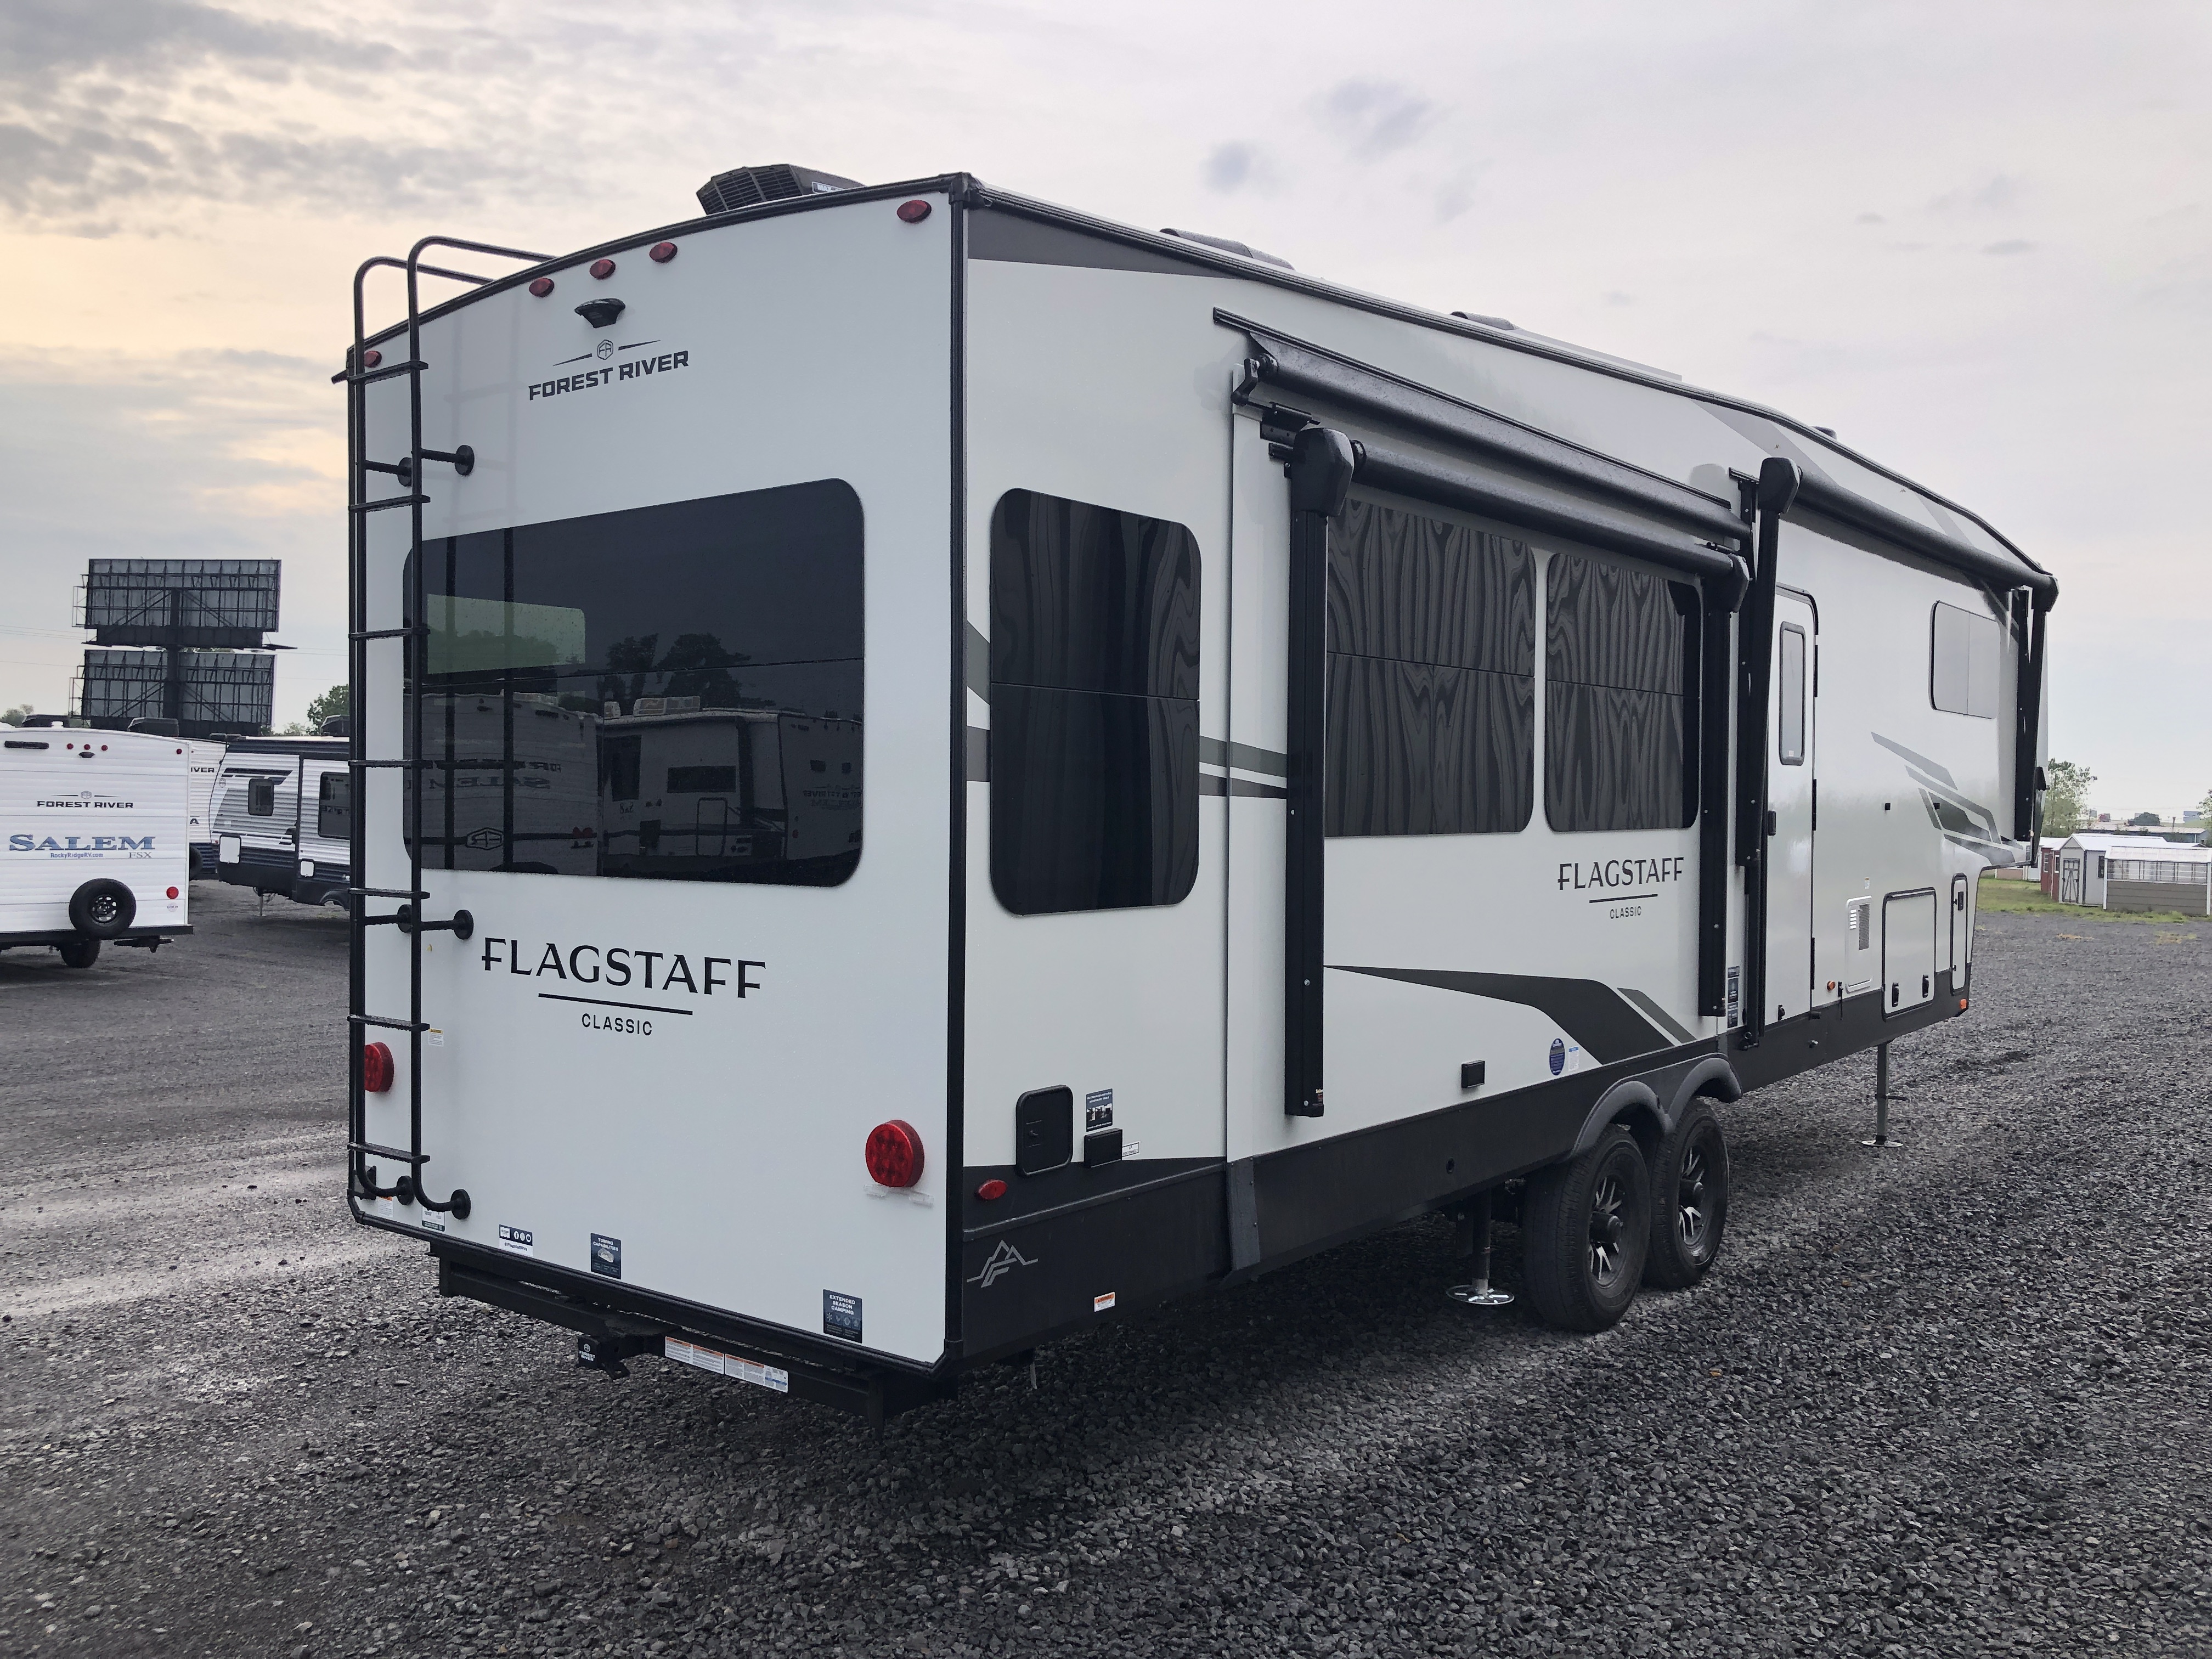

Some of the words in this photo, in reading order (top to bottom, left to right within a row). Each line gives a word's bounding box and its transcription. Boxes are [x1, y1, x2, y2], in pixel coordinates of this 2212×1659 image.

[528, 367, 613, 400] FOREST
[618, 351, 689, 381] RIVER
[9, 834, 156, 851] SALEM
[1558, 857, 1684, 890] FLAGSTAFF
[1610, 906, 1642, 919] CLASSIC
[481, 937, 766, 998] FLAGSTAFF
[582, 1013, 653, 1036] CLASSIC
[830, 1295, 855, 1305] EXTENDED
[833, 1301, 853, 1309] SEASON
[831, 1306, 854, 1315] CAMPING
